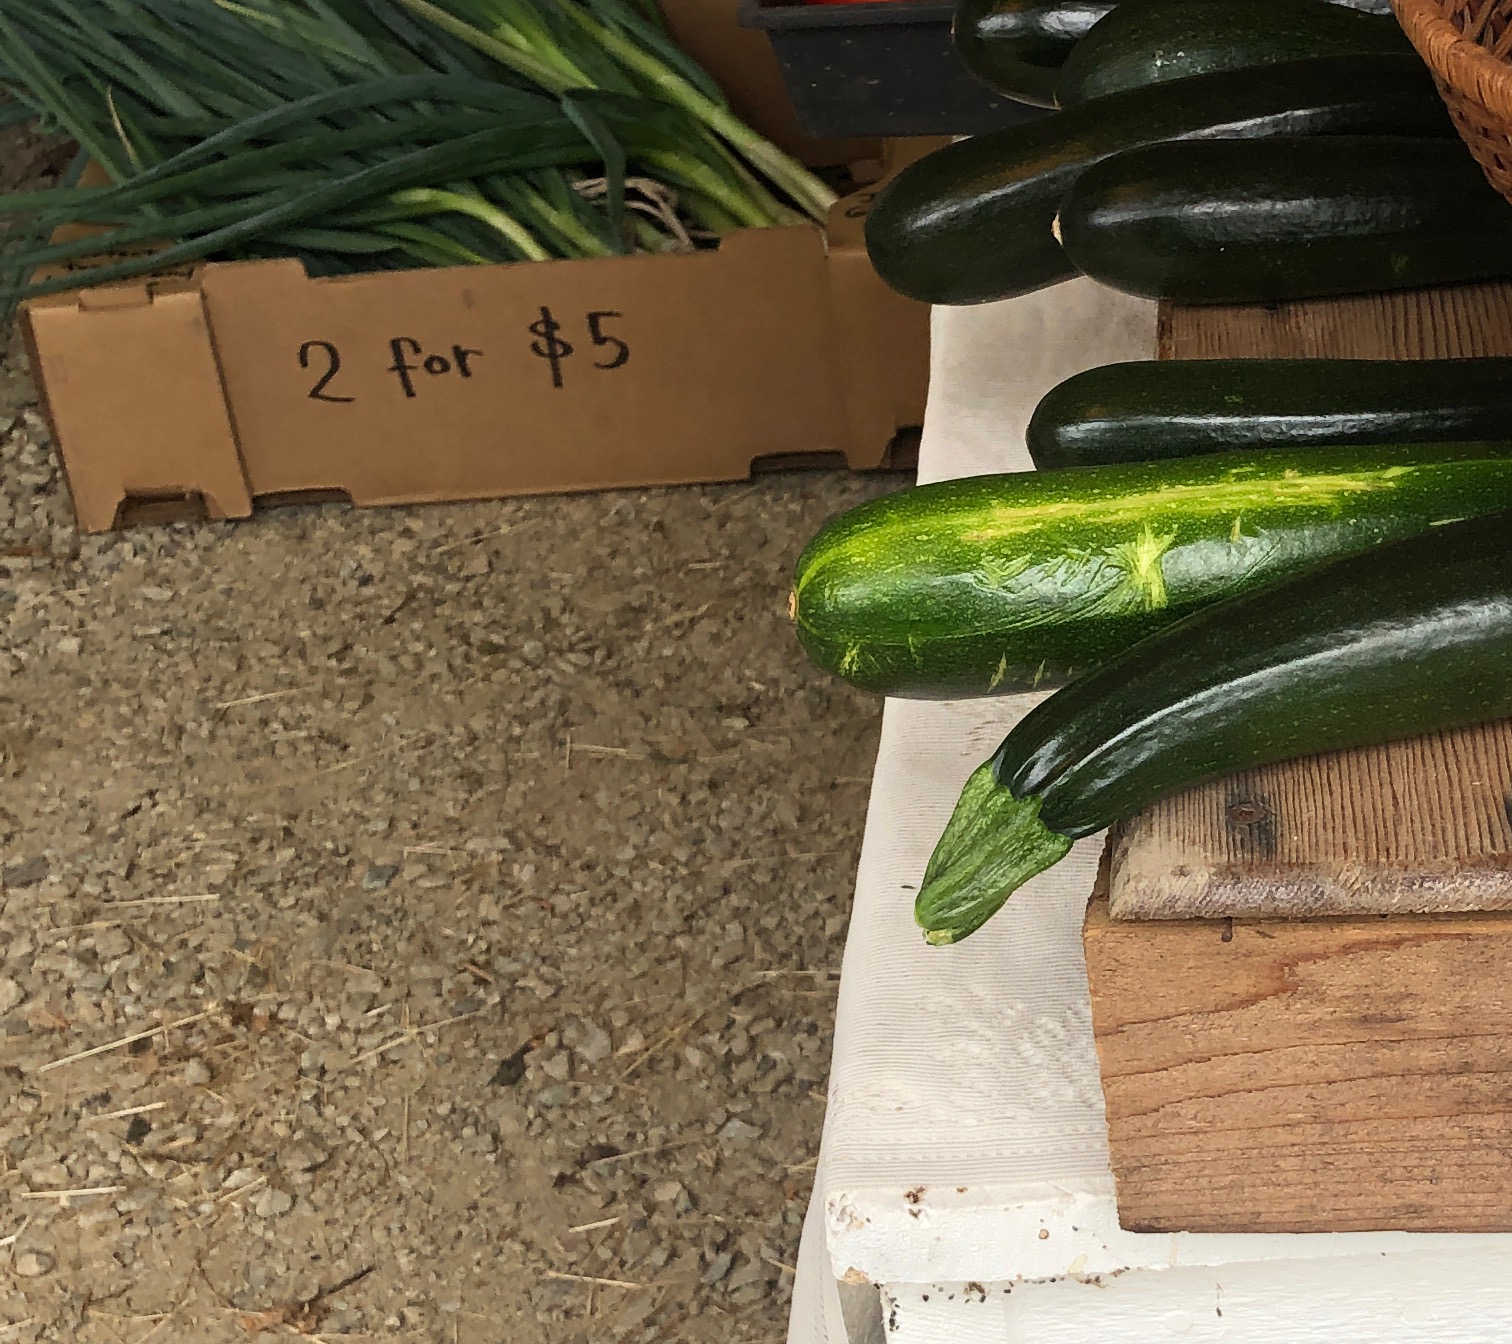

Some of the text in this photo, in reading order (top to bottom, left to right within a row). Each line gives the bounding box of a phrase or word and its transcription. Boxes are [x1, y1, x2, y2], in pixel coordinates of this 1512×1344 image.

[298, 306, 631, 404] 2 for $5
